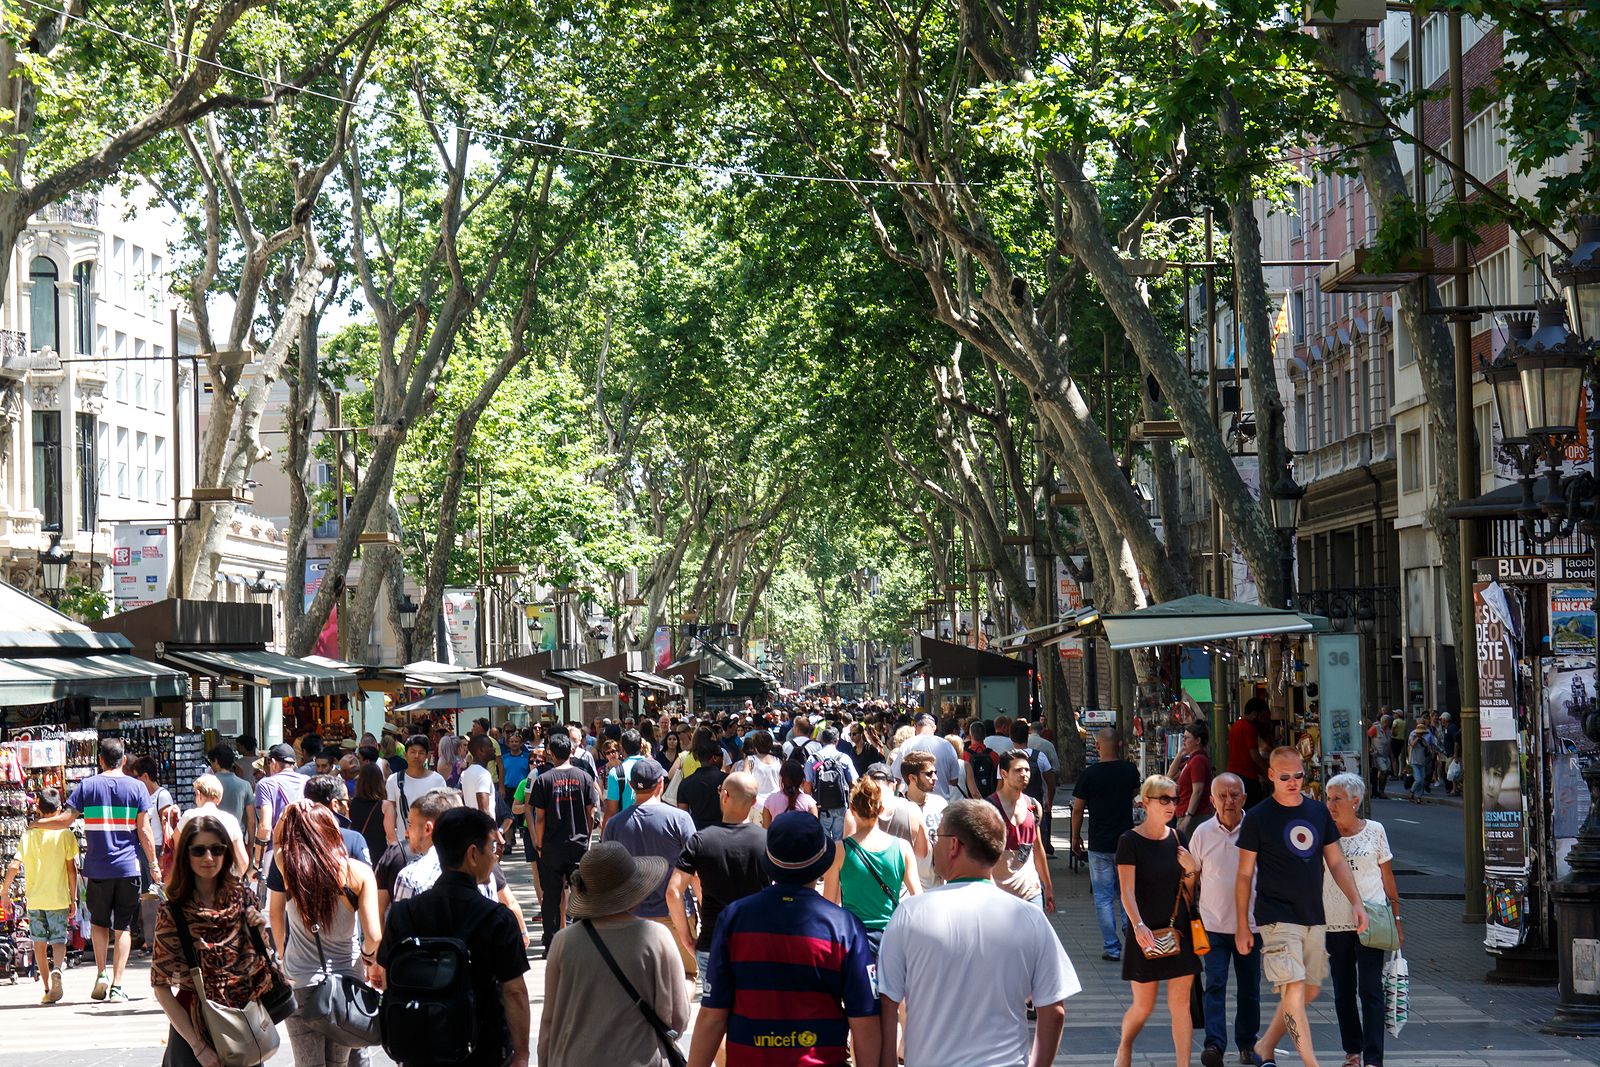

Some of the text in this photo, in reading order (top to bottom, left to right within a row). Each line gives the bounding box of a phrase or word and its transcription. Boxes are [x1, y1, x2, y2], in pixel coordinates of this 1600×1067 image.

[1498, 558, 1547, 577] BLVD
[1328, 651, 1350, 667] 36
[754, 1031, 797, 1047] unicef
